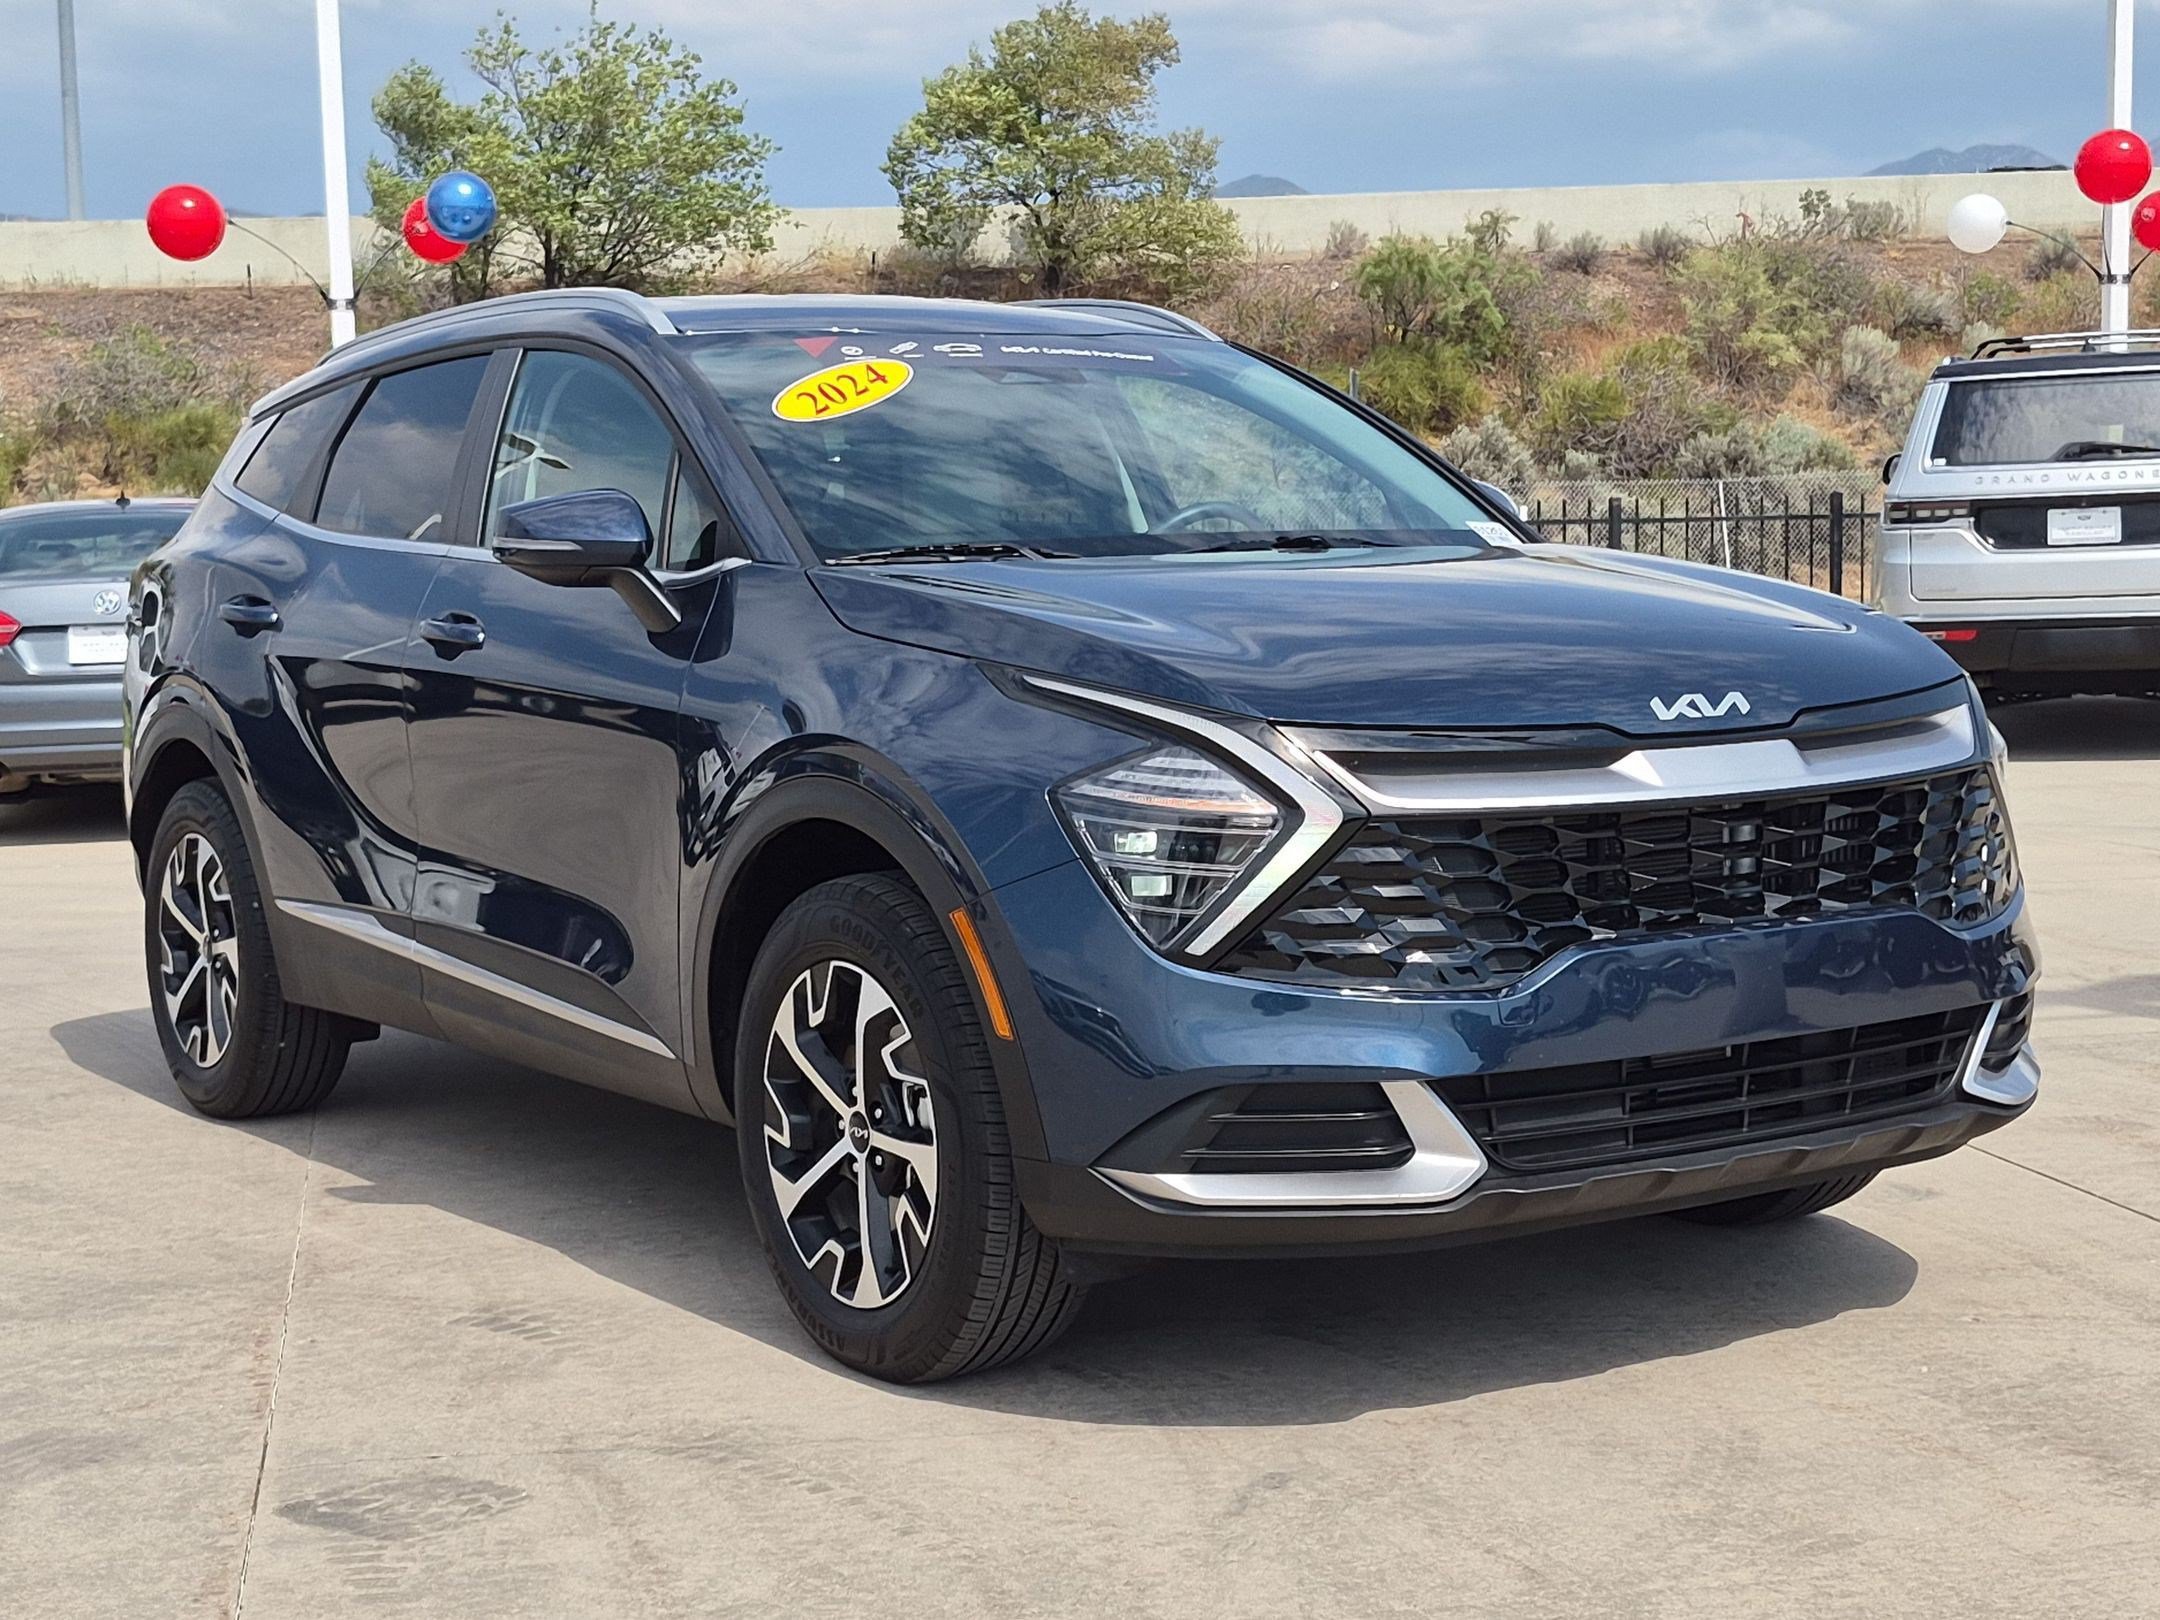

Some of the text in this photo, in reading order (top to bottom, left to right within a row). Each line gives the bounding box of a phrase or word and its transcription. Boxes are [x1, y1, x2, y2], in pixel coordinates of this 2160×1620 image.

[796, 364, 888, 415] 2024
[1975, 474, 2050, 486] GRAND
[1649, 691, 1751, 720] KIA
